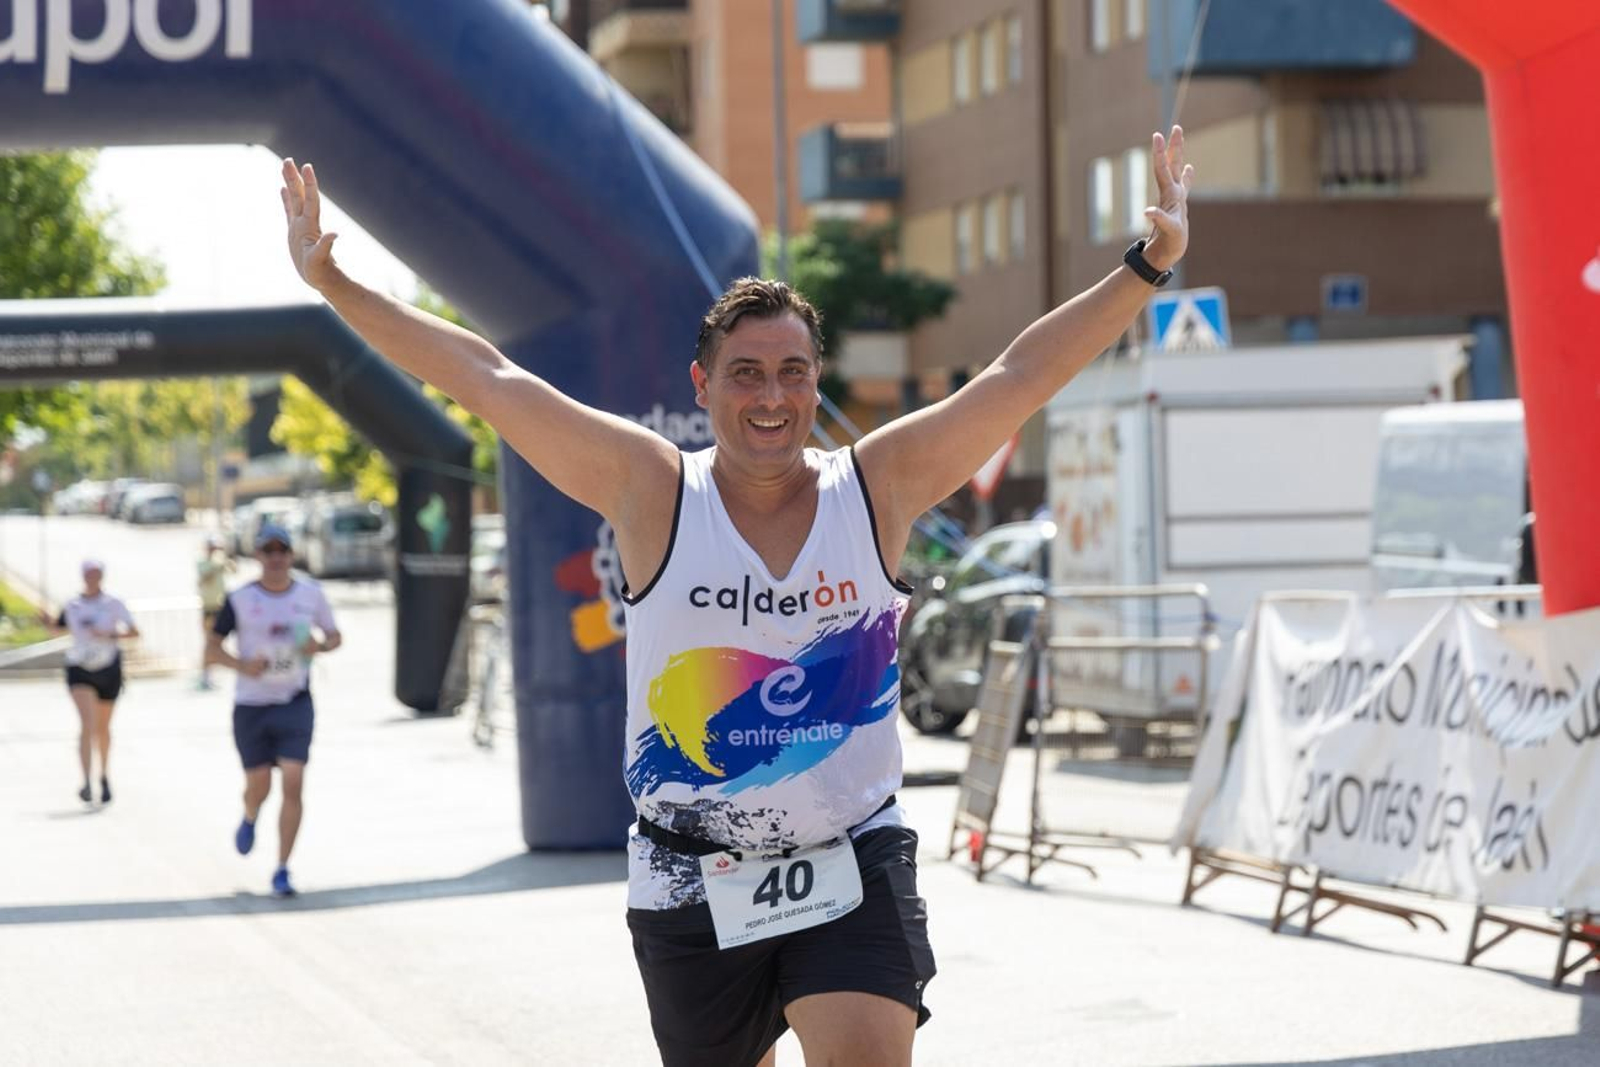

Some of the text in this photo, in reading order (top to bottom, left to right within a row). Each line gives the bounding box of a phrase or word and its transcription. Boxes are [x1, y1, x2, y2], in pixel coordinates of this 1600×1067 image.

[689, 570, 858, 626] calderón
[728, 719, 844, 747] entrénate
[753, 859, 814, 908] 40
[745, 917, 766, 930] PEDRO
[767, 912, 783, 924] JOSÉ
[783, 906, 813, 918] QUESADA
[814, 899, 836, 910] GÓMEZ
